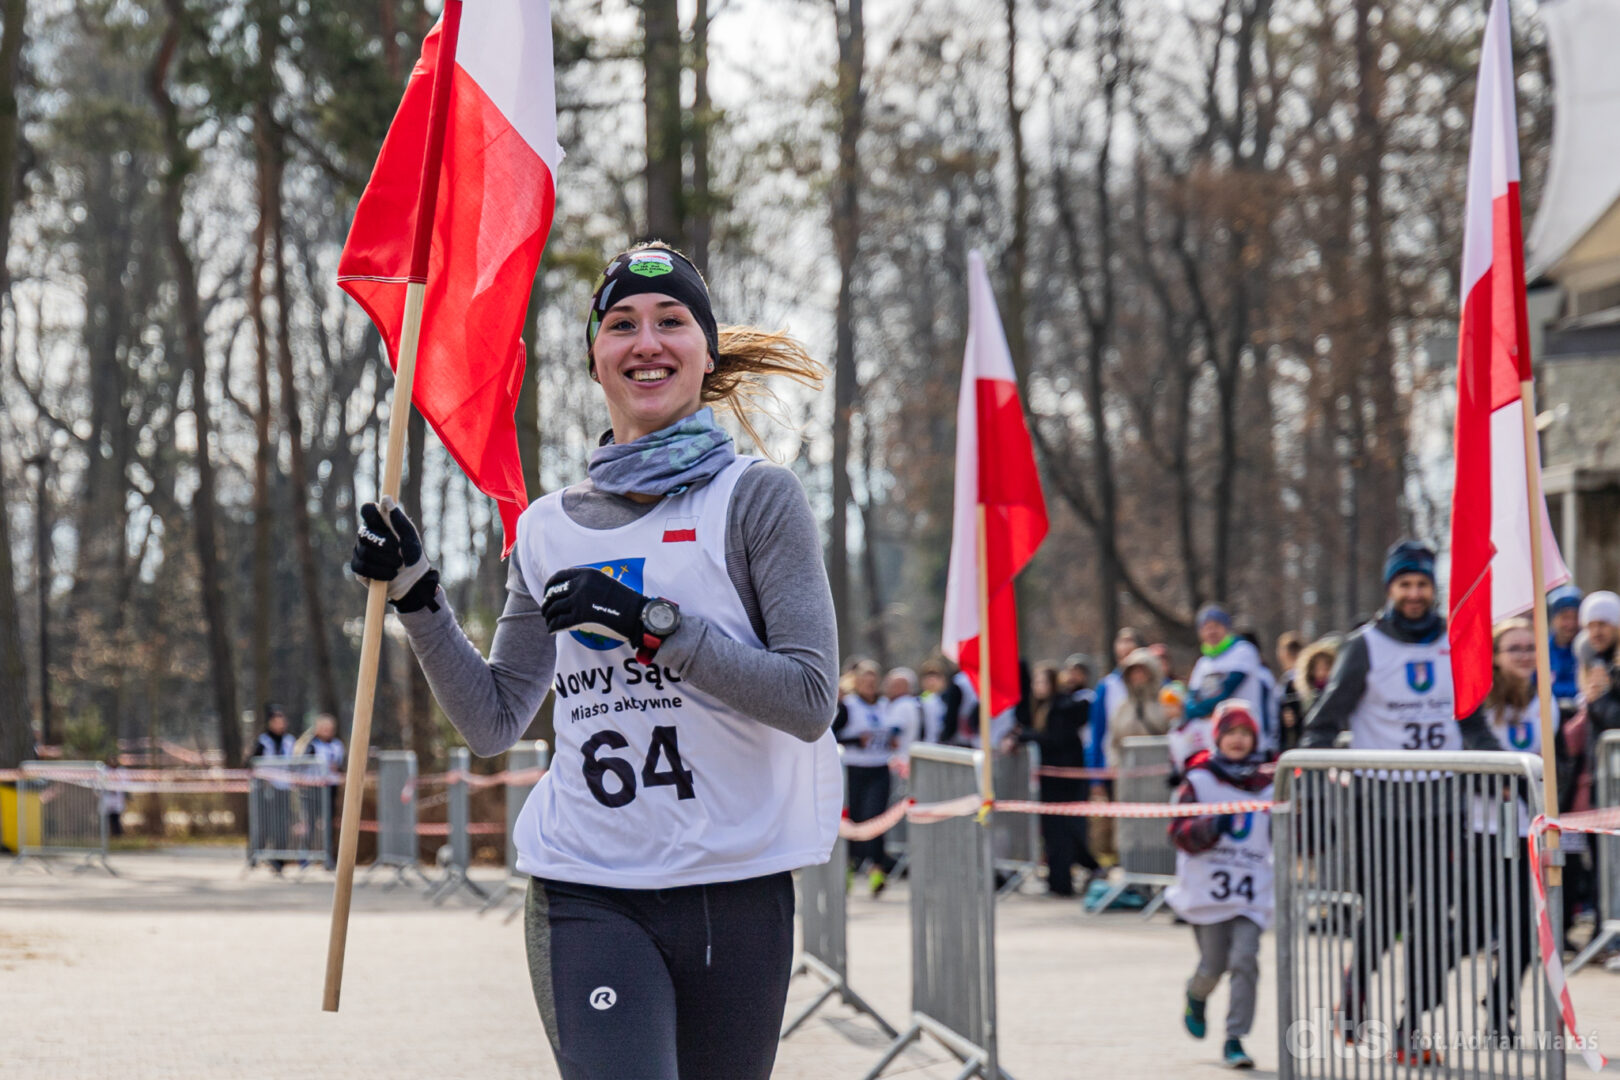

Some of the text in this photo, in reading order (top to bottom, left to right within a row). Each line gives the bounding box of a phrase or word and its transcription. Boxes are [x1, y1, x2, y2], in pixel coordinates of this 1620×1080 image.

[614, 696, 682, 712] aktywne
[1402, 722, 1446, 750] 36
[581, 726, 695, 808] 64
[1210, 870, 1254, 904] 34
